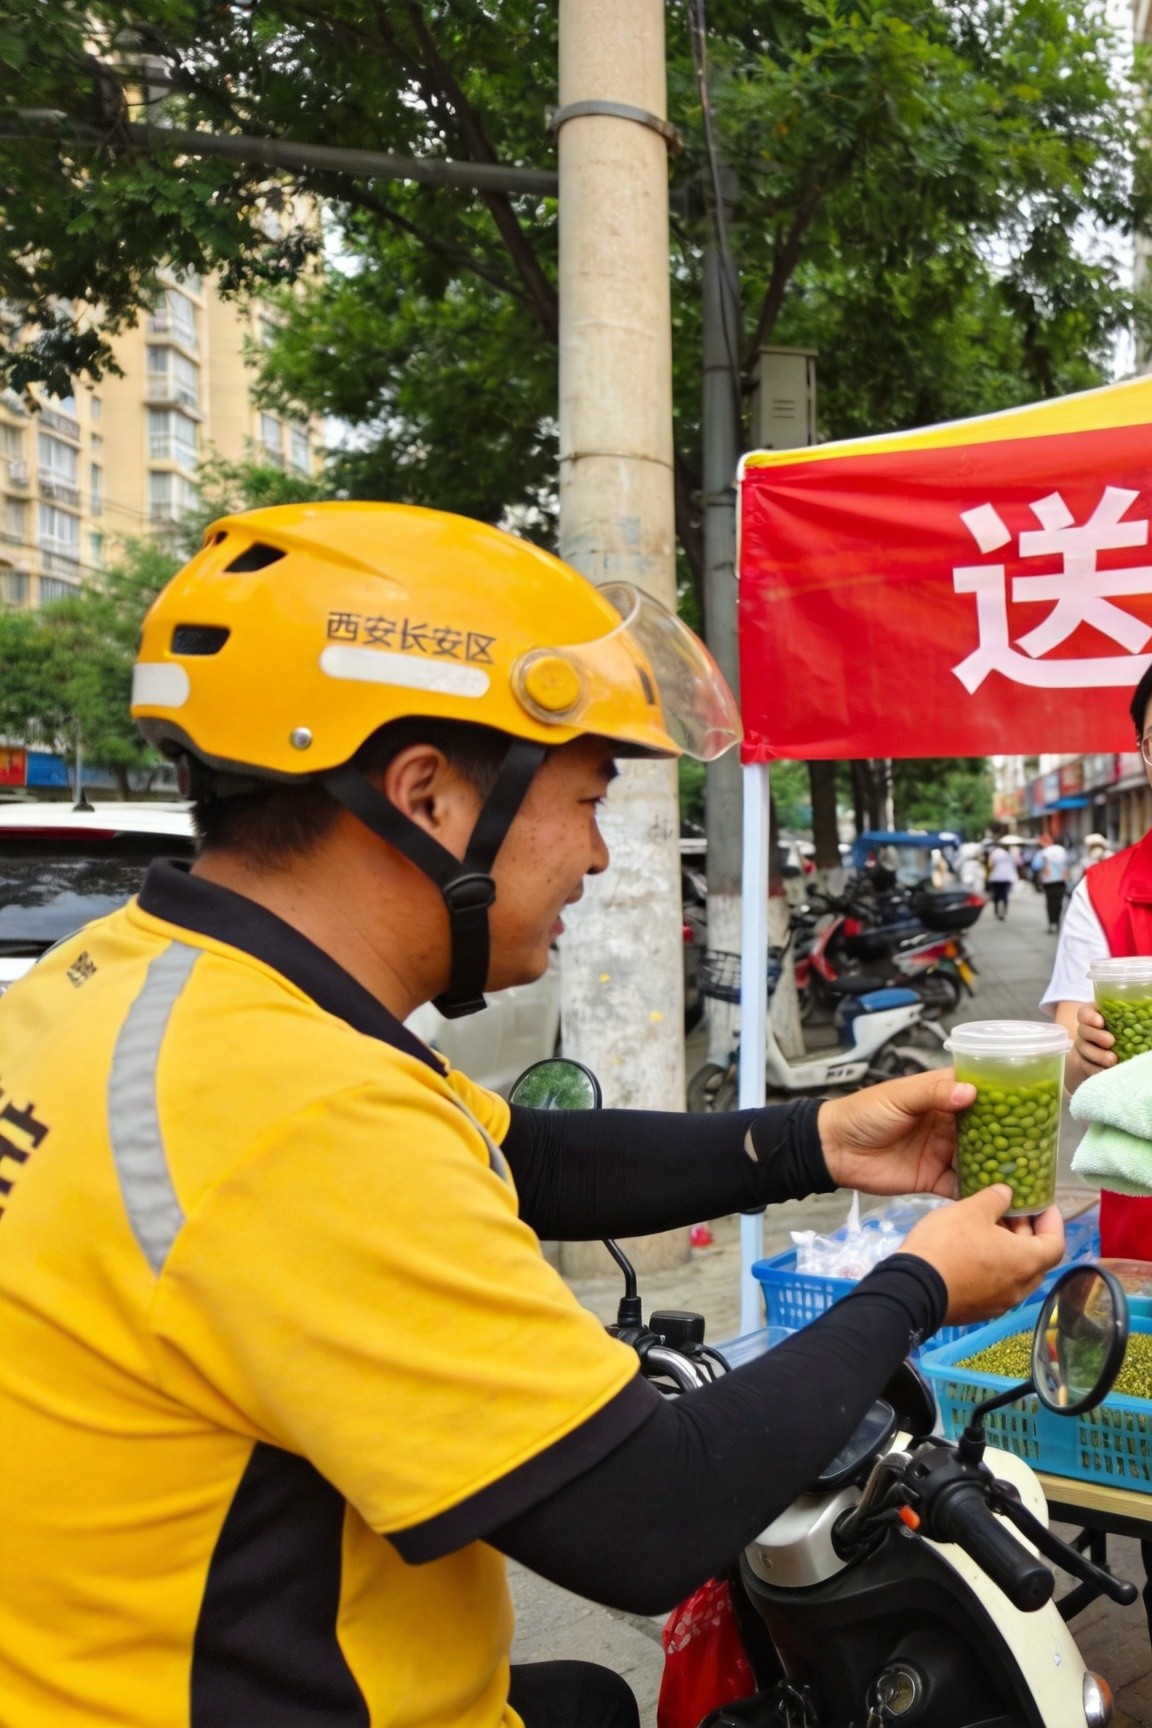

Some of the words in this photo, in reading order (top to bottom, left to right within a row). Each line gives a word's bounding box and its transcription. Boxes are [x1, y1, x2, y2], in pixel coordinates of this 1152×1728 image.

[327, 611, 497, 665] 西安长安区
